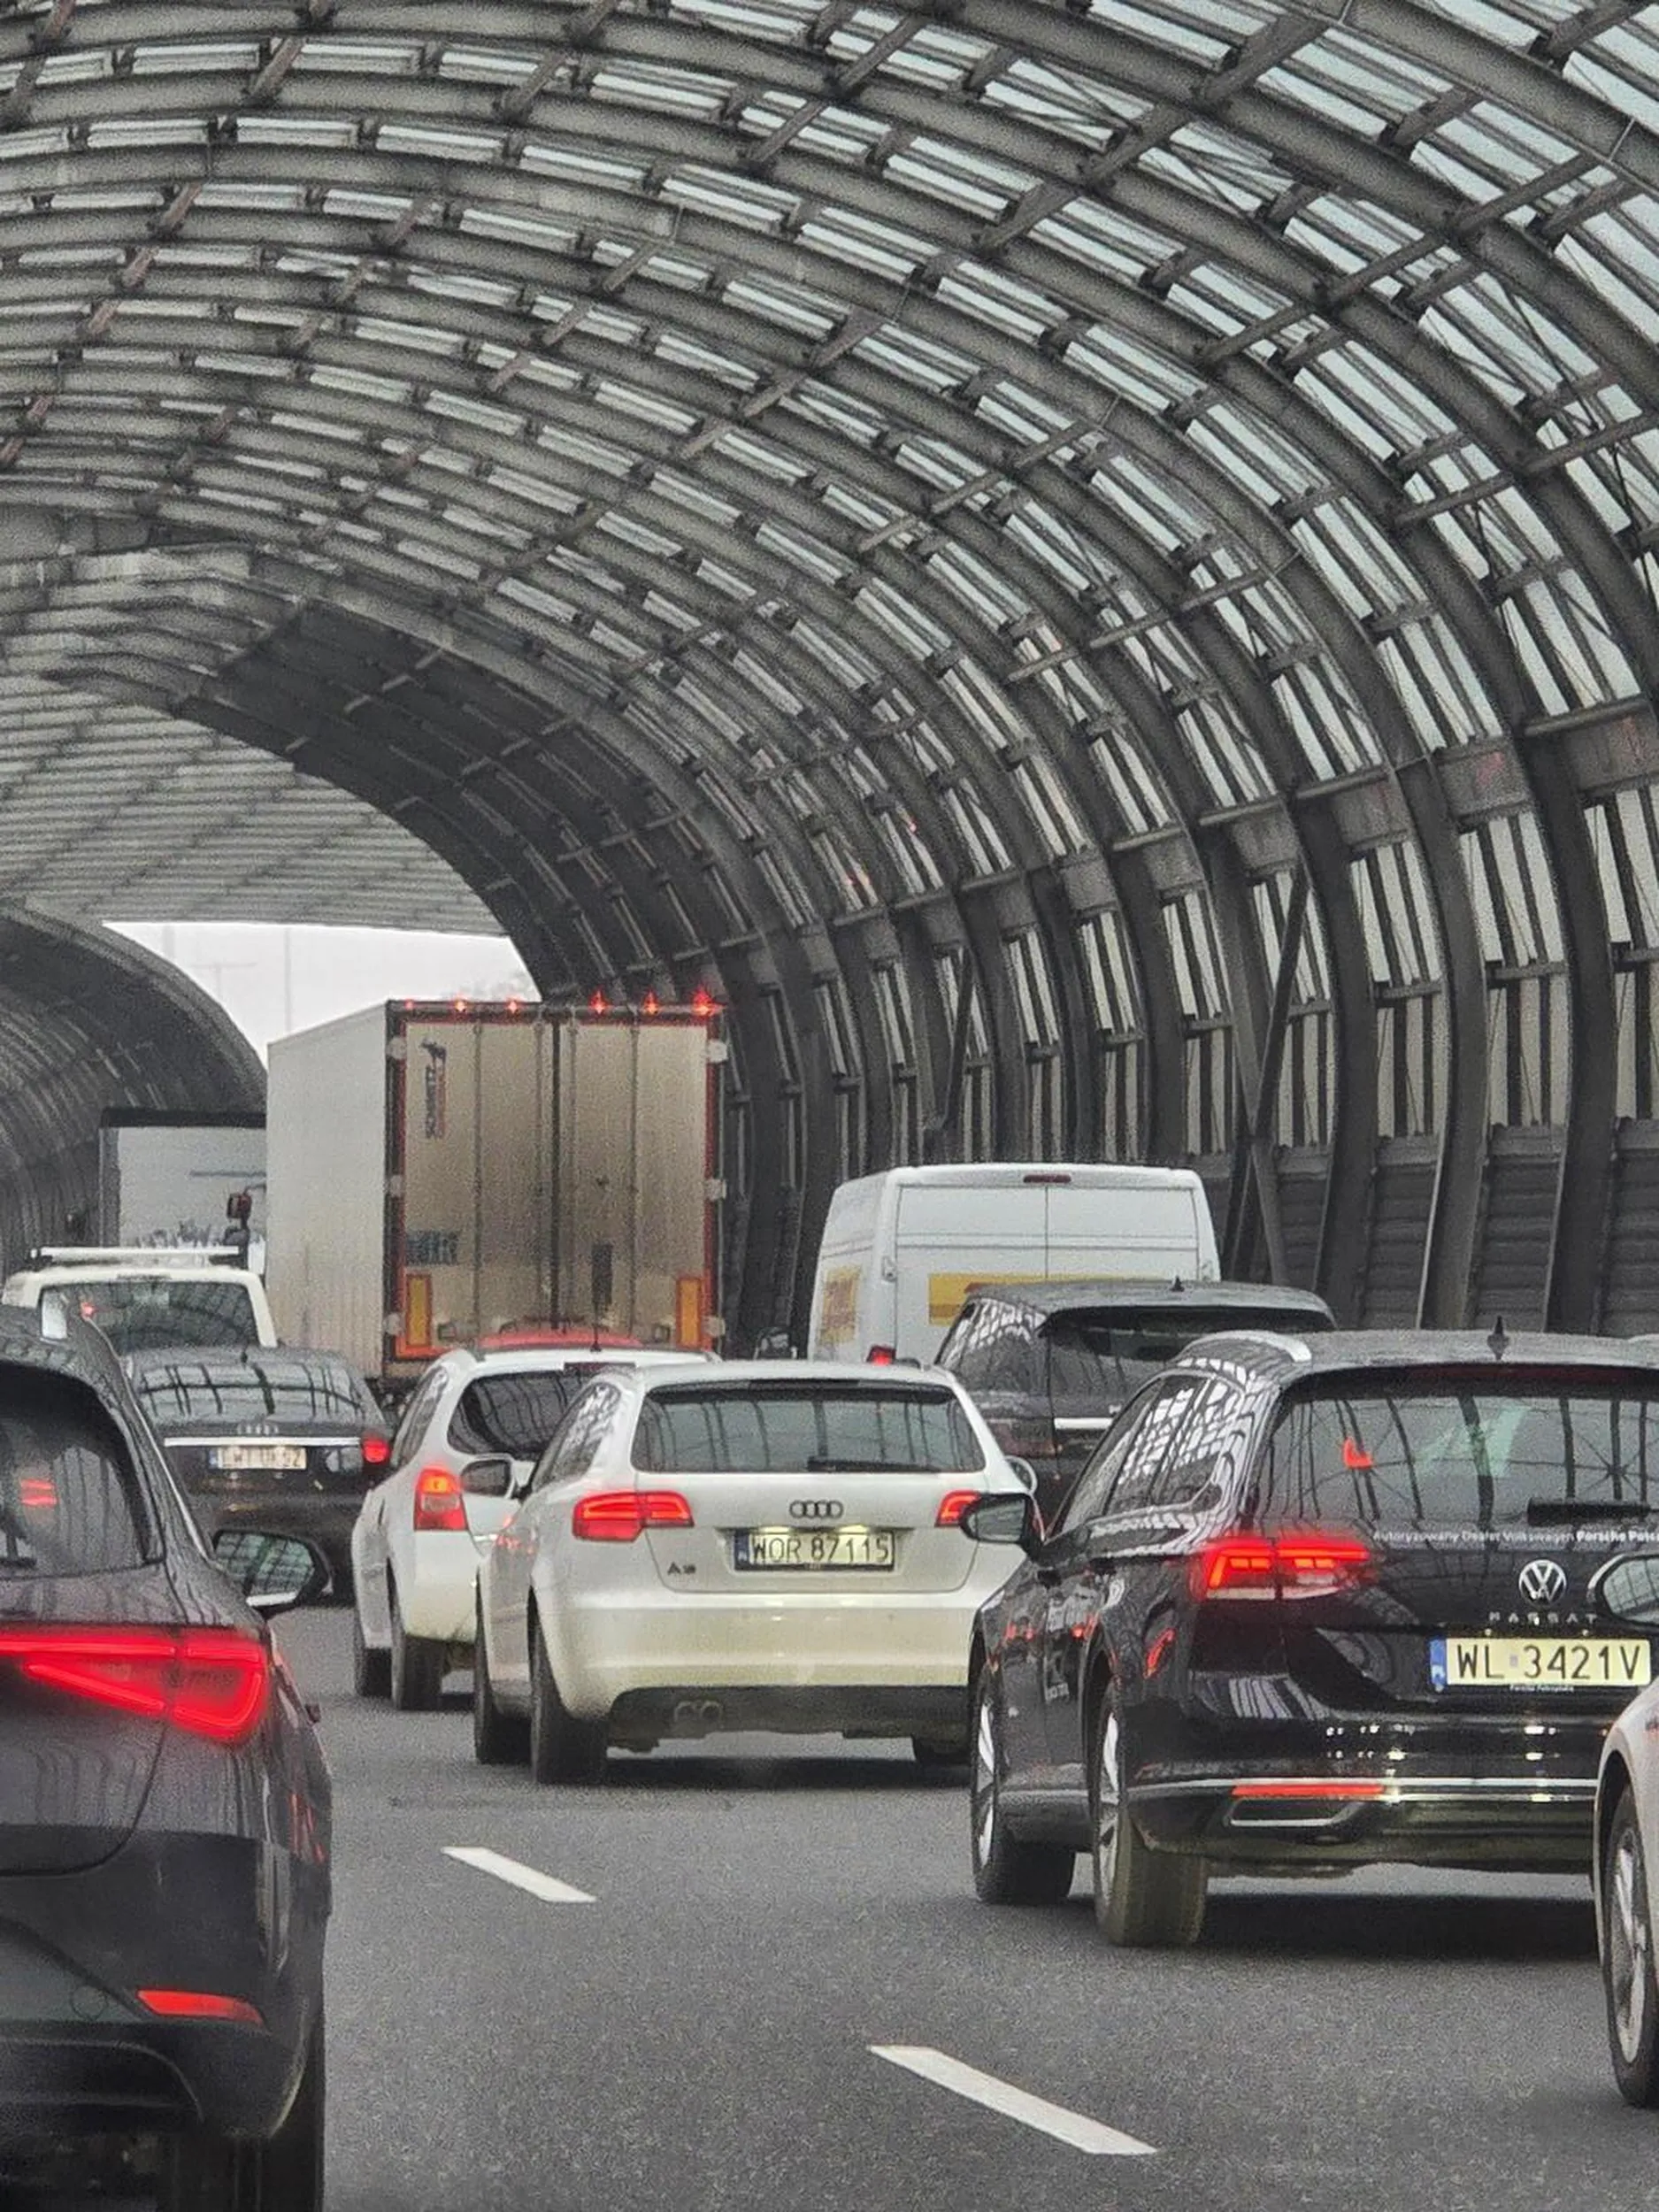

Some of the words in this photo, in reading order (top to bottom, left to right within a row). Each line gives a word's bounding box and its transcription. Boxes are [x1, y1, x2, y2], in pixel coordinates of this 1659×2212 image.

[1502, 1531, 1575, 1544] Volkswagen
[1577, 1530, 1626, 1542] Porsche
[752, 1536, 802, 1562] WOR
[810, 1534, 889, 1563] 87115
[1489, 1611, 1598, 1624] PASSAT
[1457, 1644, 1505, 1679] WL
[1523, 1644, 1640, 1680] 3421V
